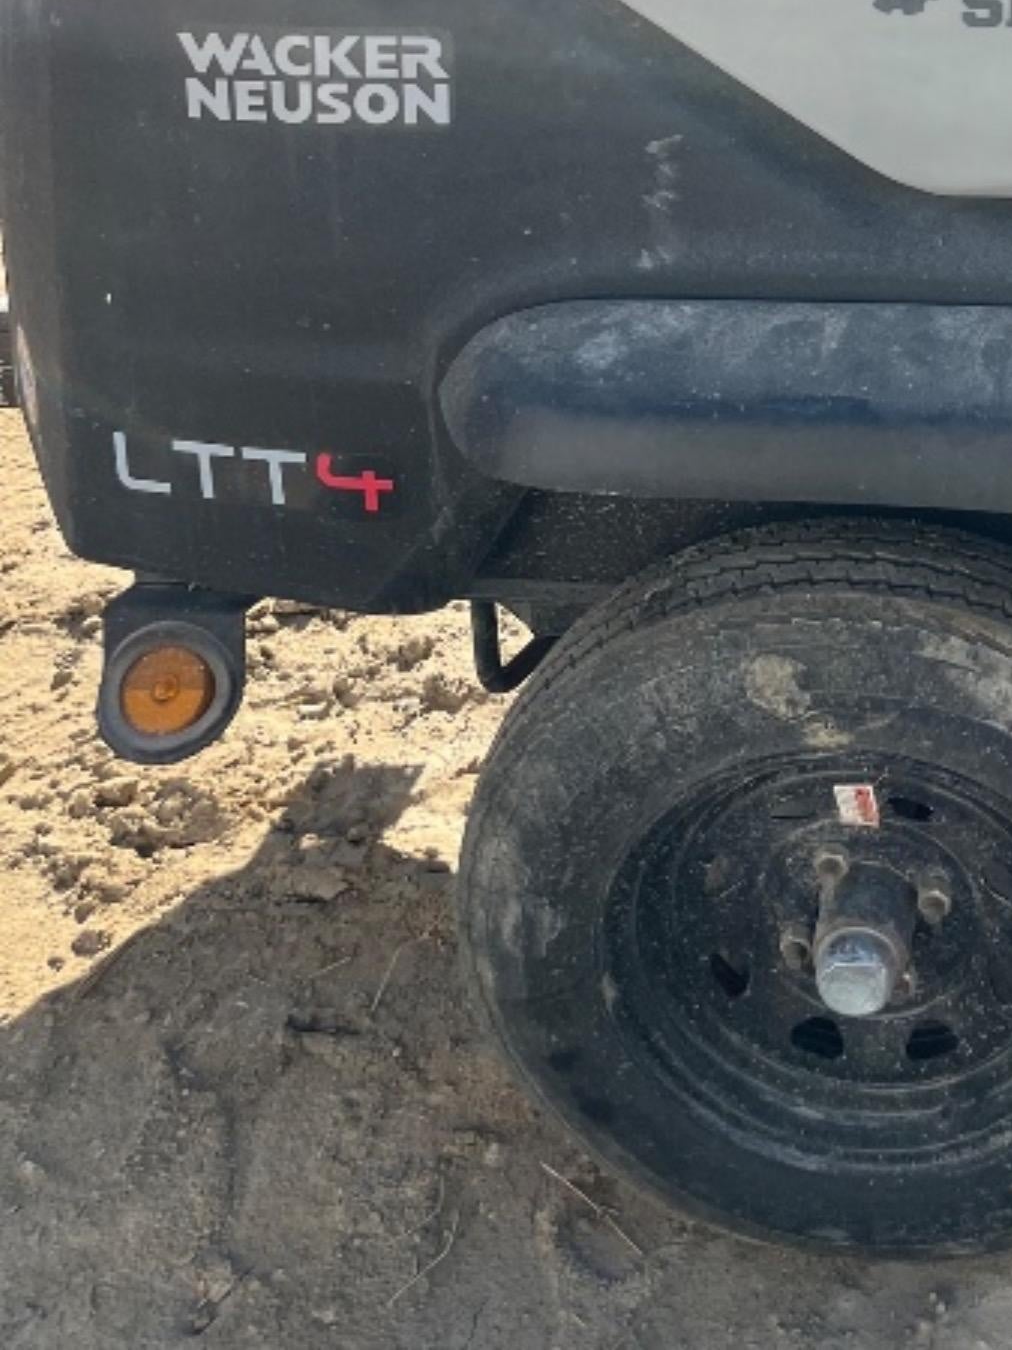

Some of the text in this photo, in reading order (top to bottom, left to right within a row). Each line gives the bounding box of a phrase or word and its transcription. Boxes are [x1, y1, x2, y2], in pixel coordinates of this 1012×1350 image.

[176, 31, 449, 79] WACKER
[185, 77, 452, 125] NEUSON
[112, 431, 394, 513] LTT4
